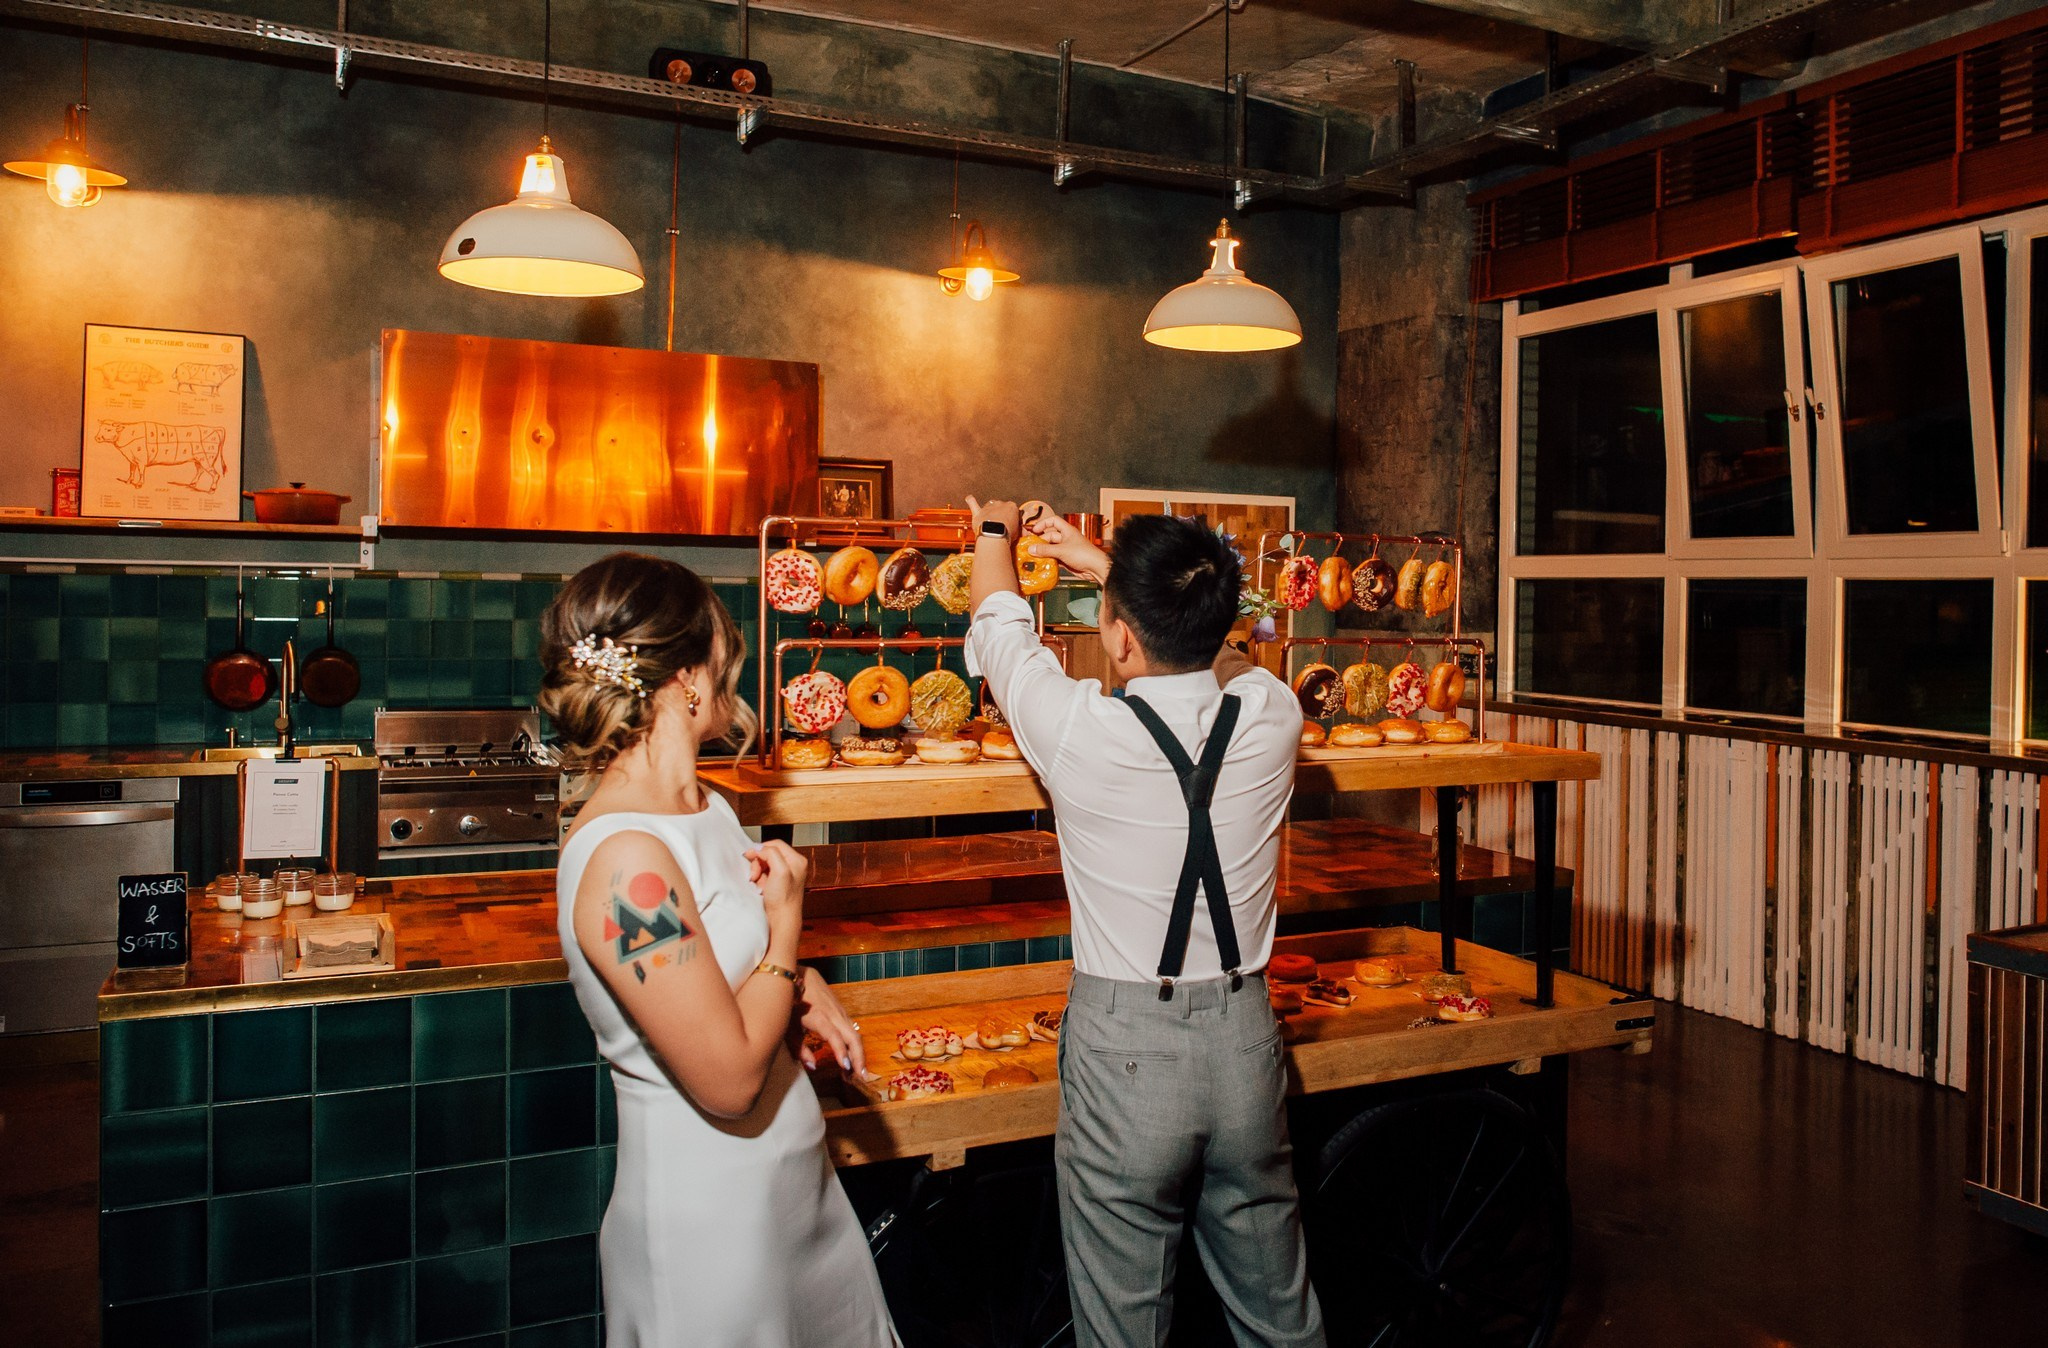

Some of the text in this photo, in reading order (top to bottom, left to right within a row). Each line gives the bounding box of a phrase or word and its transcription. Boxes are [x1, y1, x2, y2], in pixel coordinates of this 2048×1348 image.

[121, 877, 186, 898] WASSER
[145, 905, 159, 925] &
[121, 931, 178, 953] SOFTS
